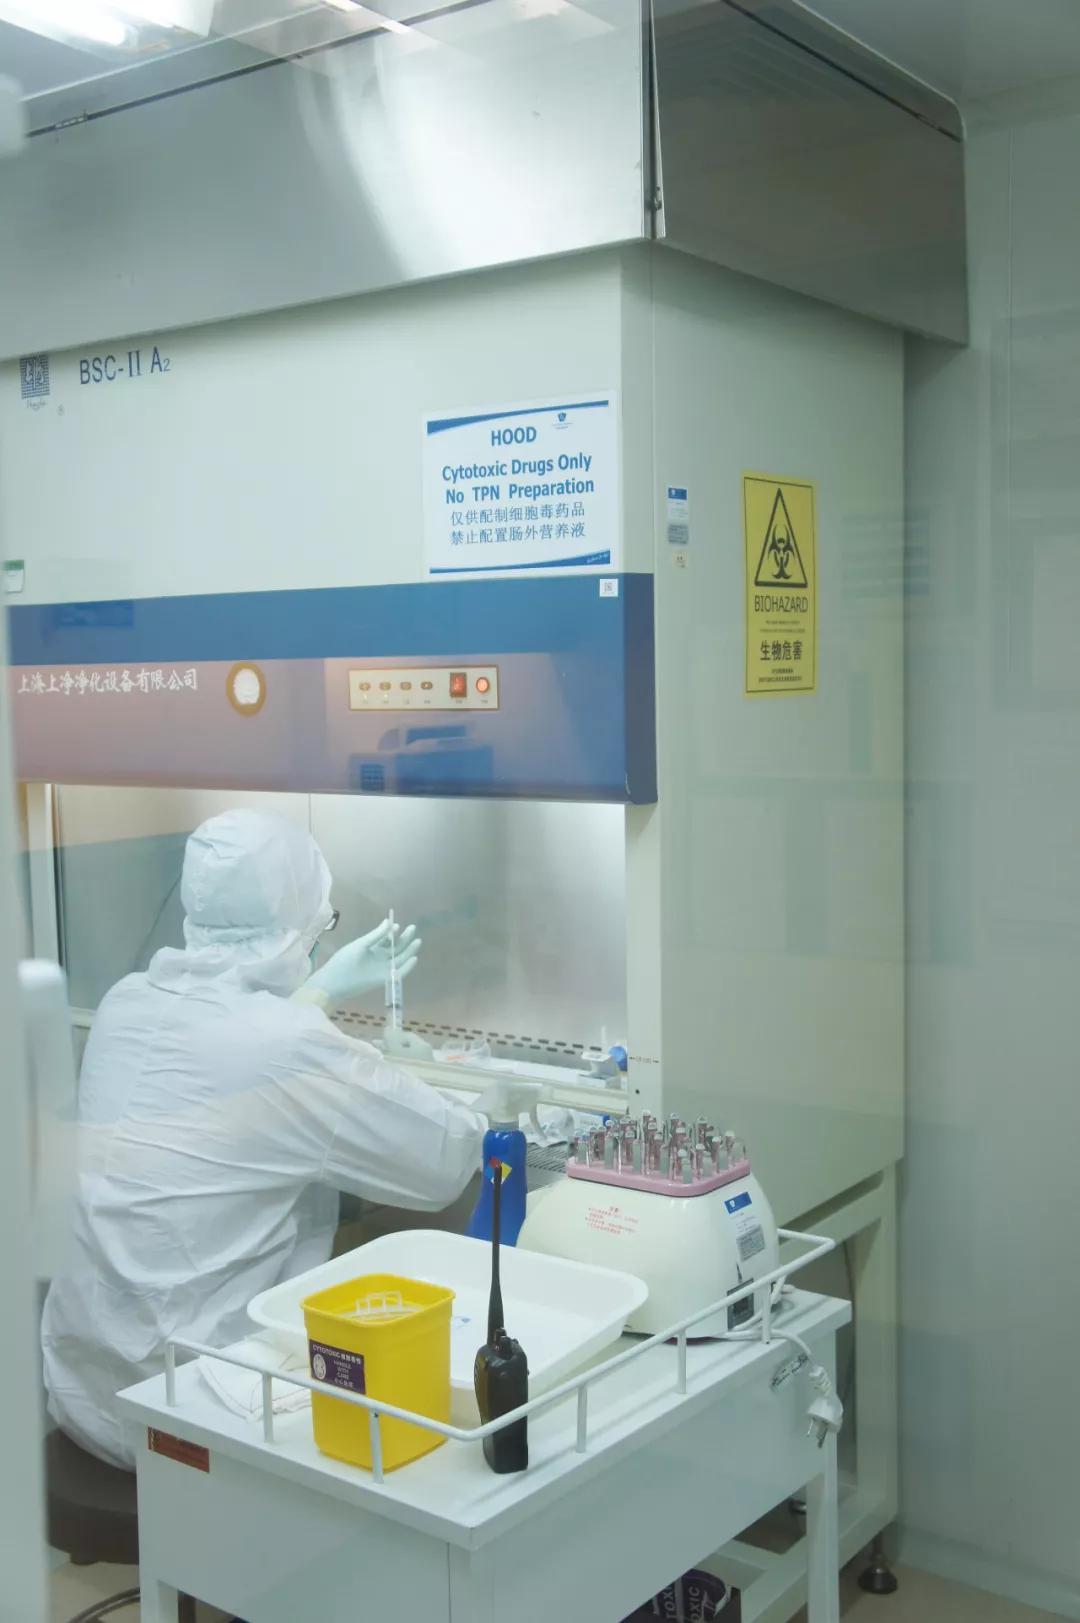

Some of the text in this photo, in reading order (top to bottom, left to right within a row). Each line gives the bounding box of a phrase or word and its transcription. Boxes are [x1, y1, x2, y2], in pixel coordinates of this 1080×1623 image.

[490, 426, 537, 446] HOOD
[442, 452, 592, 484] Cytotoxic Drugs Only
[446, 477, 595, 504] No TPN Preparation
[451, 501, 586, 527] 仅供配制细胞毒药品
[450, 521, 586, 546] 禁止配置肠外营养液
[754, 594, 809, 613] BIOHAZARD
[760, 640, 803, 661] 生物危害
[17, 667, 198, 696] 上海上净净化设备有限公司
